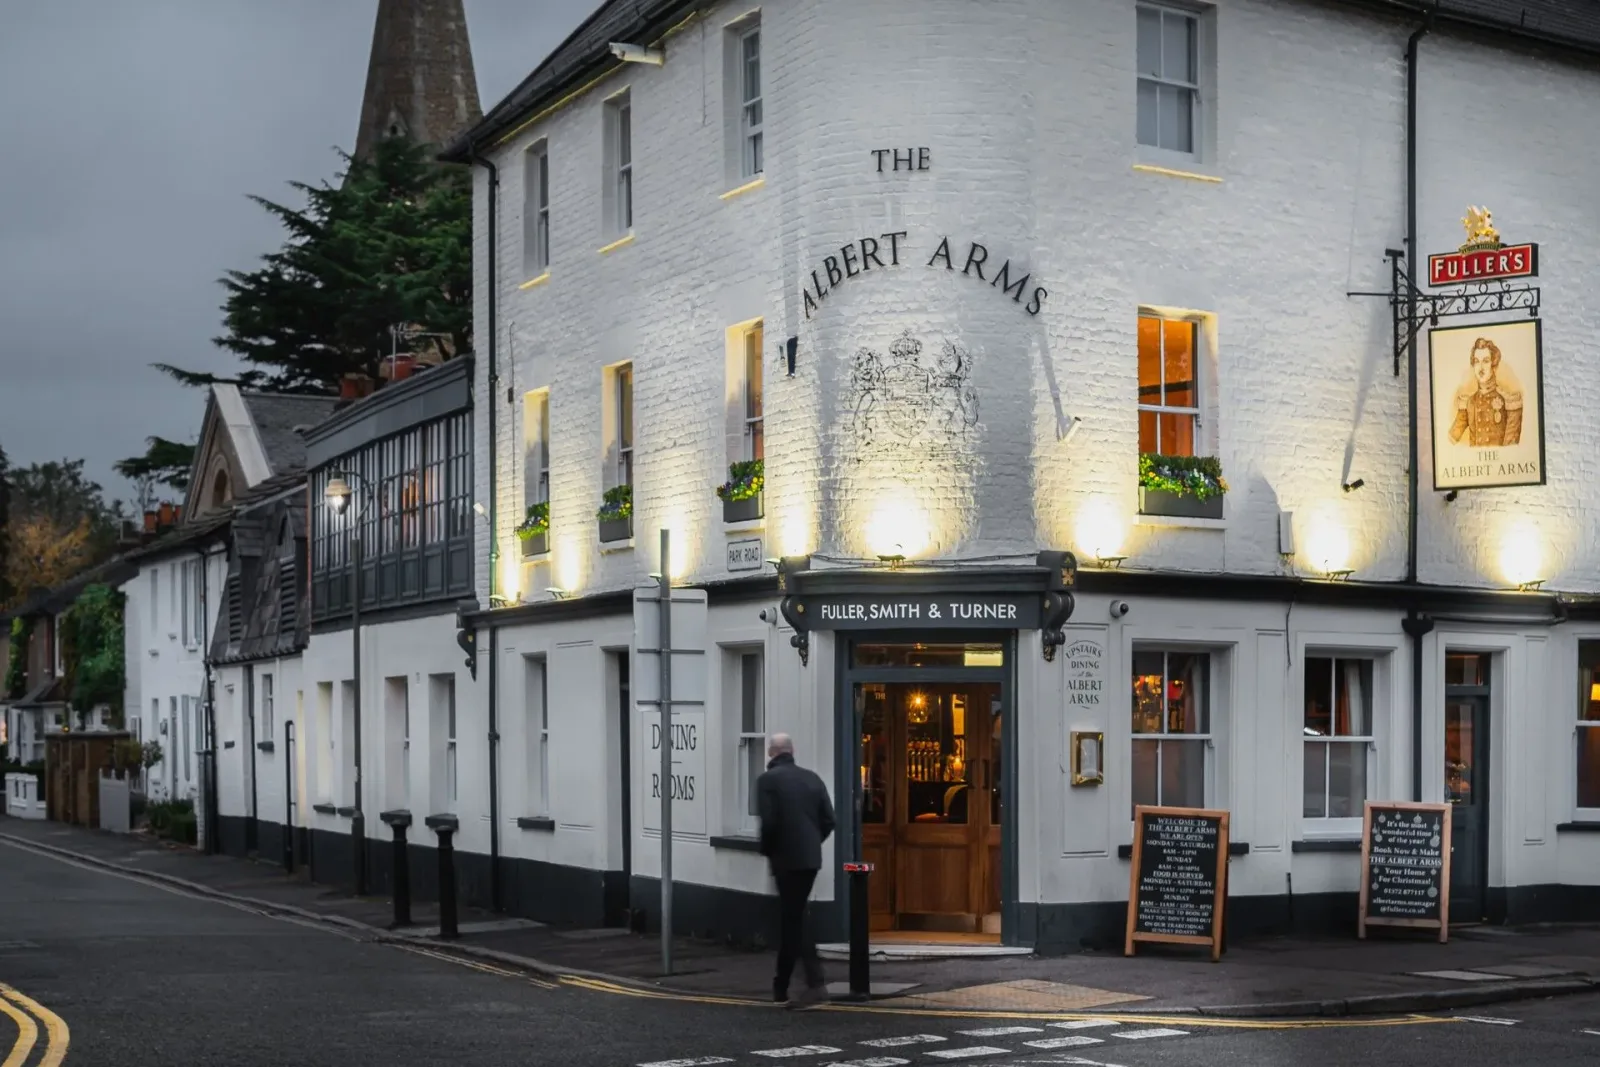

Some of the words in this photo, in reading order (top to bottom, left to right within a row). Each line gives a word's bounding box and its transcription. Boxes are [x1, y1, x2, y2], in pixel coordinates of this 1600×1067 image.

[871, 147, 930, 172] THE
[1435, 252, 1524, 278] FULLER'S
[802, 231, 908, 319] ALBERT
[926, 236, 1048, 316] ARMS
[1477, 451, 1498, 461] THE
[1443, 464, 1492, 478] ALBERT
[1498, 462, 1536, 476] ARMS
[729, 550, 742, 563] PARK
[744, 547, 758, 562] ROAD
[870, 604, 920, 618] SMITH
[928, 604, 941, 618] &
[950, 604, 1016, 618] TURNER
[1066, 645, 1102, 659] UPSTAIRS
[1072, 660, 1099, 669] DINING
[1067, 680, 1102, 690] ALBERT
[1070, 694, 1100, 704] ARMS
[652, 773, 694, 800] ROMS
[1148, 824, 1164, 832] THE
[1158, 818, 1196, 826] WELCOME
[1392, 876, 1430, 884] Christmas!
